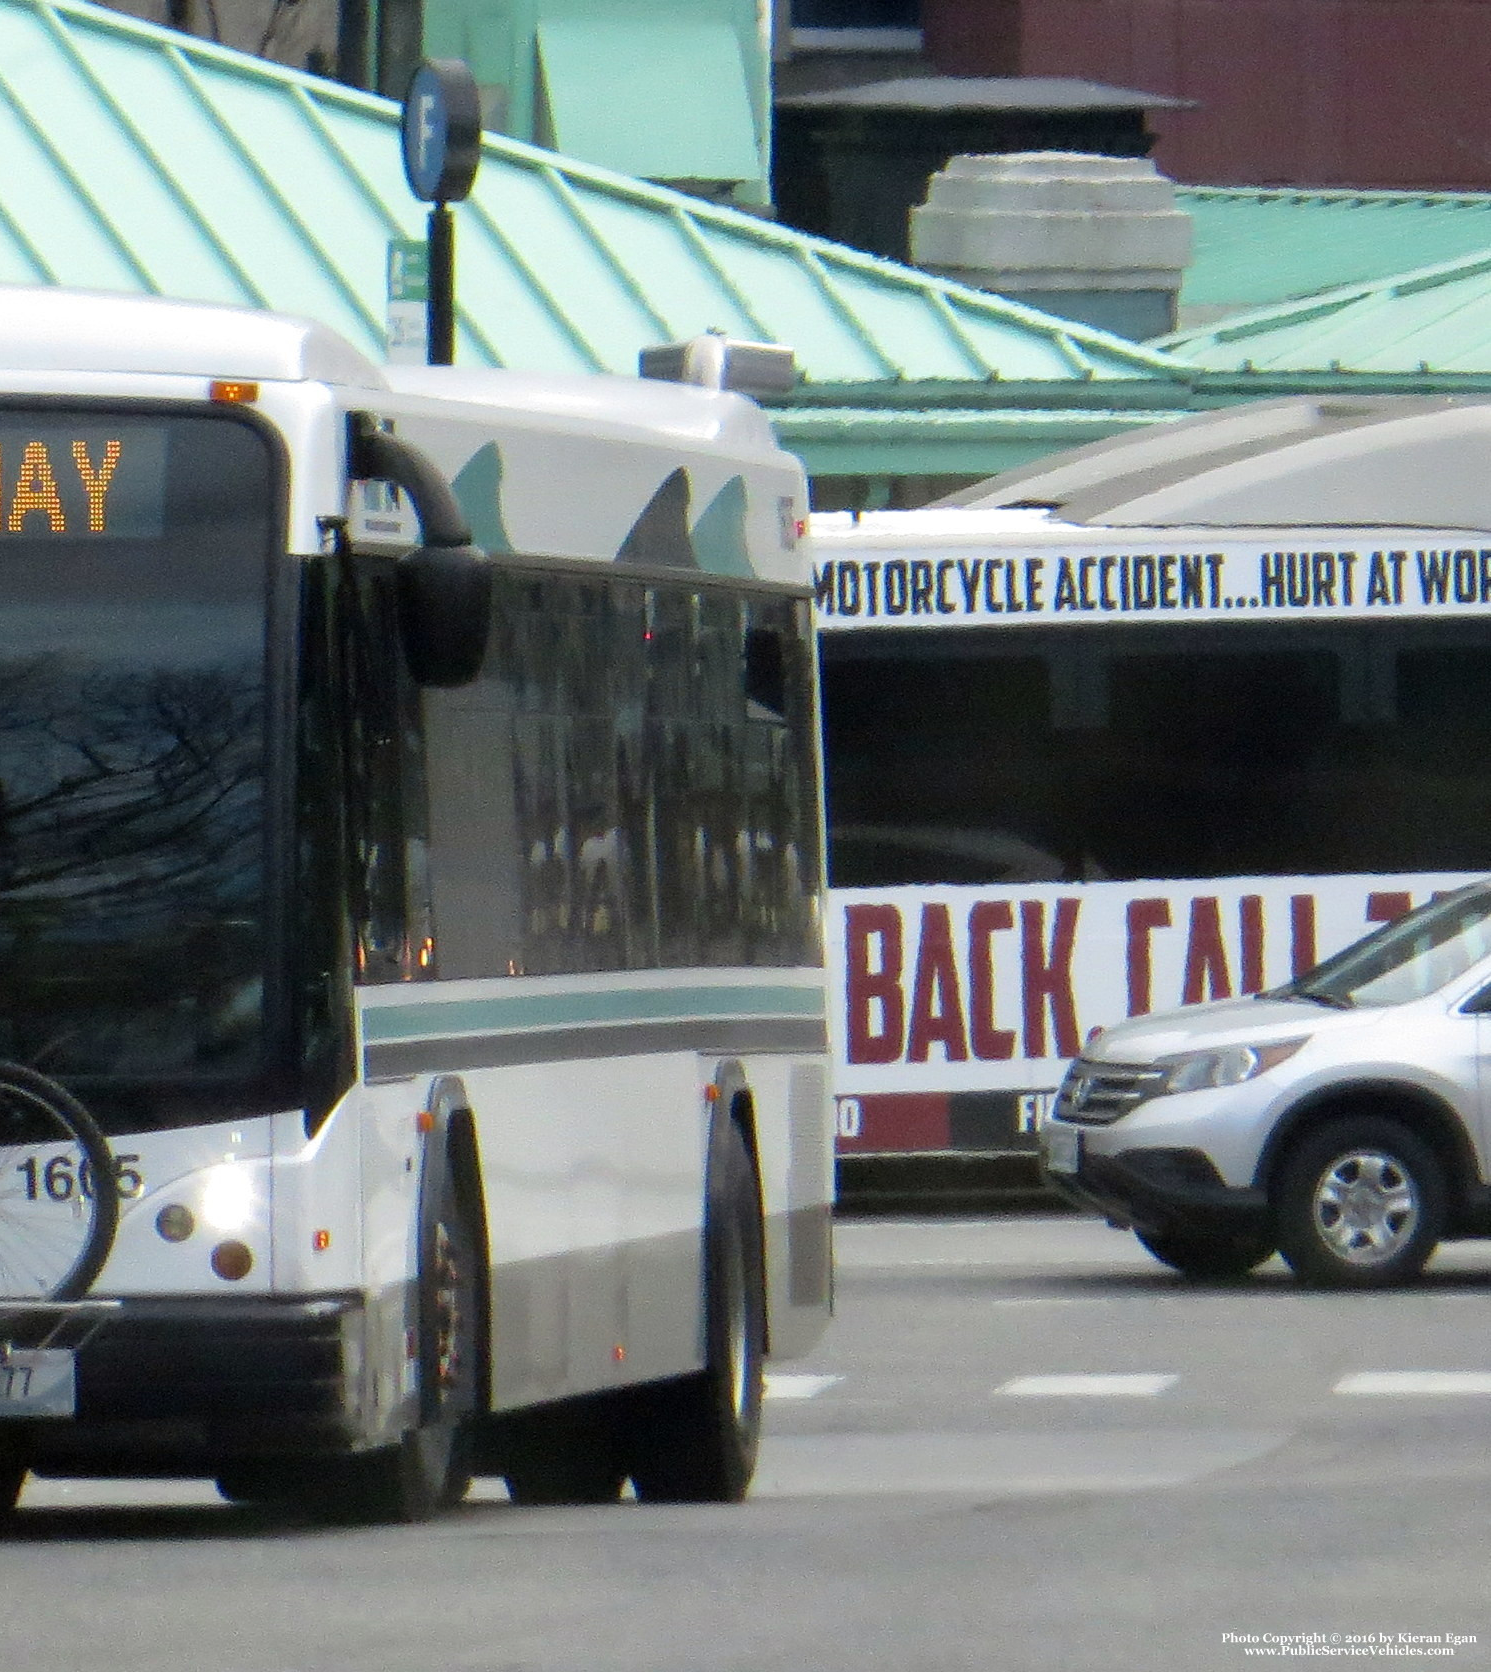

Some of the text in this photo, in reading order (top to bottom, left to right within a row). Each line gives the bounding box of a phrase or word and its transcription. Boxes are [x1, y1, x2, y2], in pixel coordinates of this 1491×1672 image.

[812, 557, 1044, 616] MOTORCYCLE
[1366, 550, 1408, 606] AT
[844, 897, 1082, 1064] BACK
